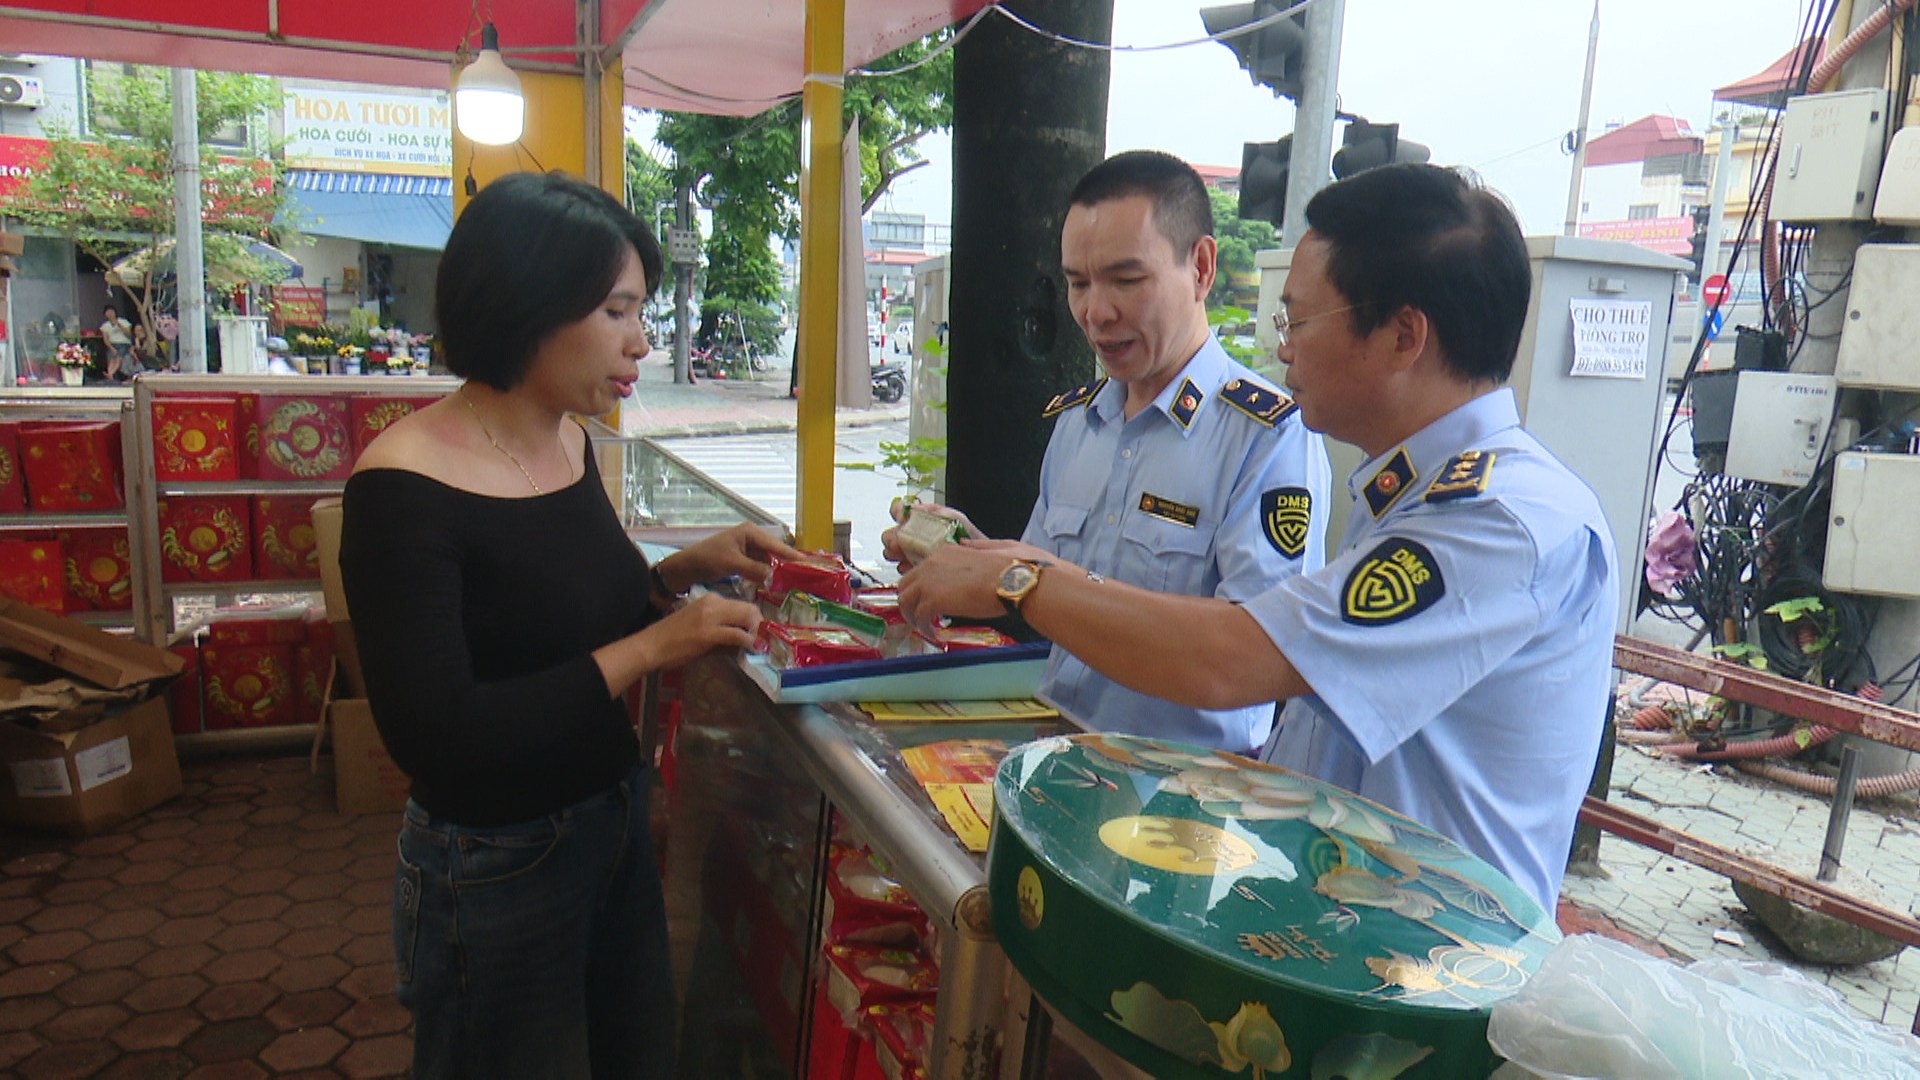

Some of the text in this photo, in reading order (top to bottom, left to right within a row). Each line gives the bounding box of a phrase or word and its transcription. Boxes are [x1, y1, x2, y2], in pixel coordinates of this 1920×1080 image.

[294, 97, 351, 122] HOA
[358, 102, 420, 128] TƯƠI
[299, 127, 331, 141] HOA
[335, 127, 372, 144] CƯỚI
[388, 133, 419, 147] HOA
[423, 135, 441, 151] SỰ
[376, 151, 391, 160] HOA
[1574, 305, 1649, 326] CHO THUÊ
[1621, 330, 1645, 347] TRỌ
[1277, 495, 1309, 508] DMS
[1391, 548, 1431, 585] DMS
